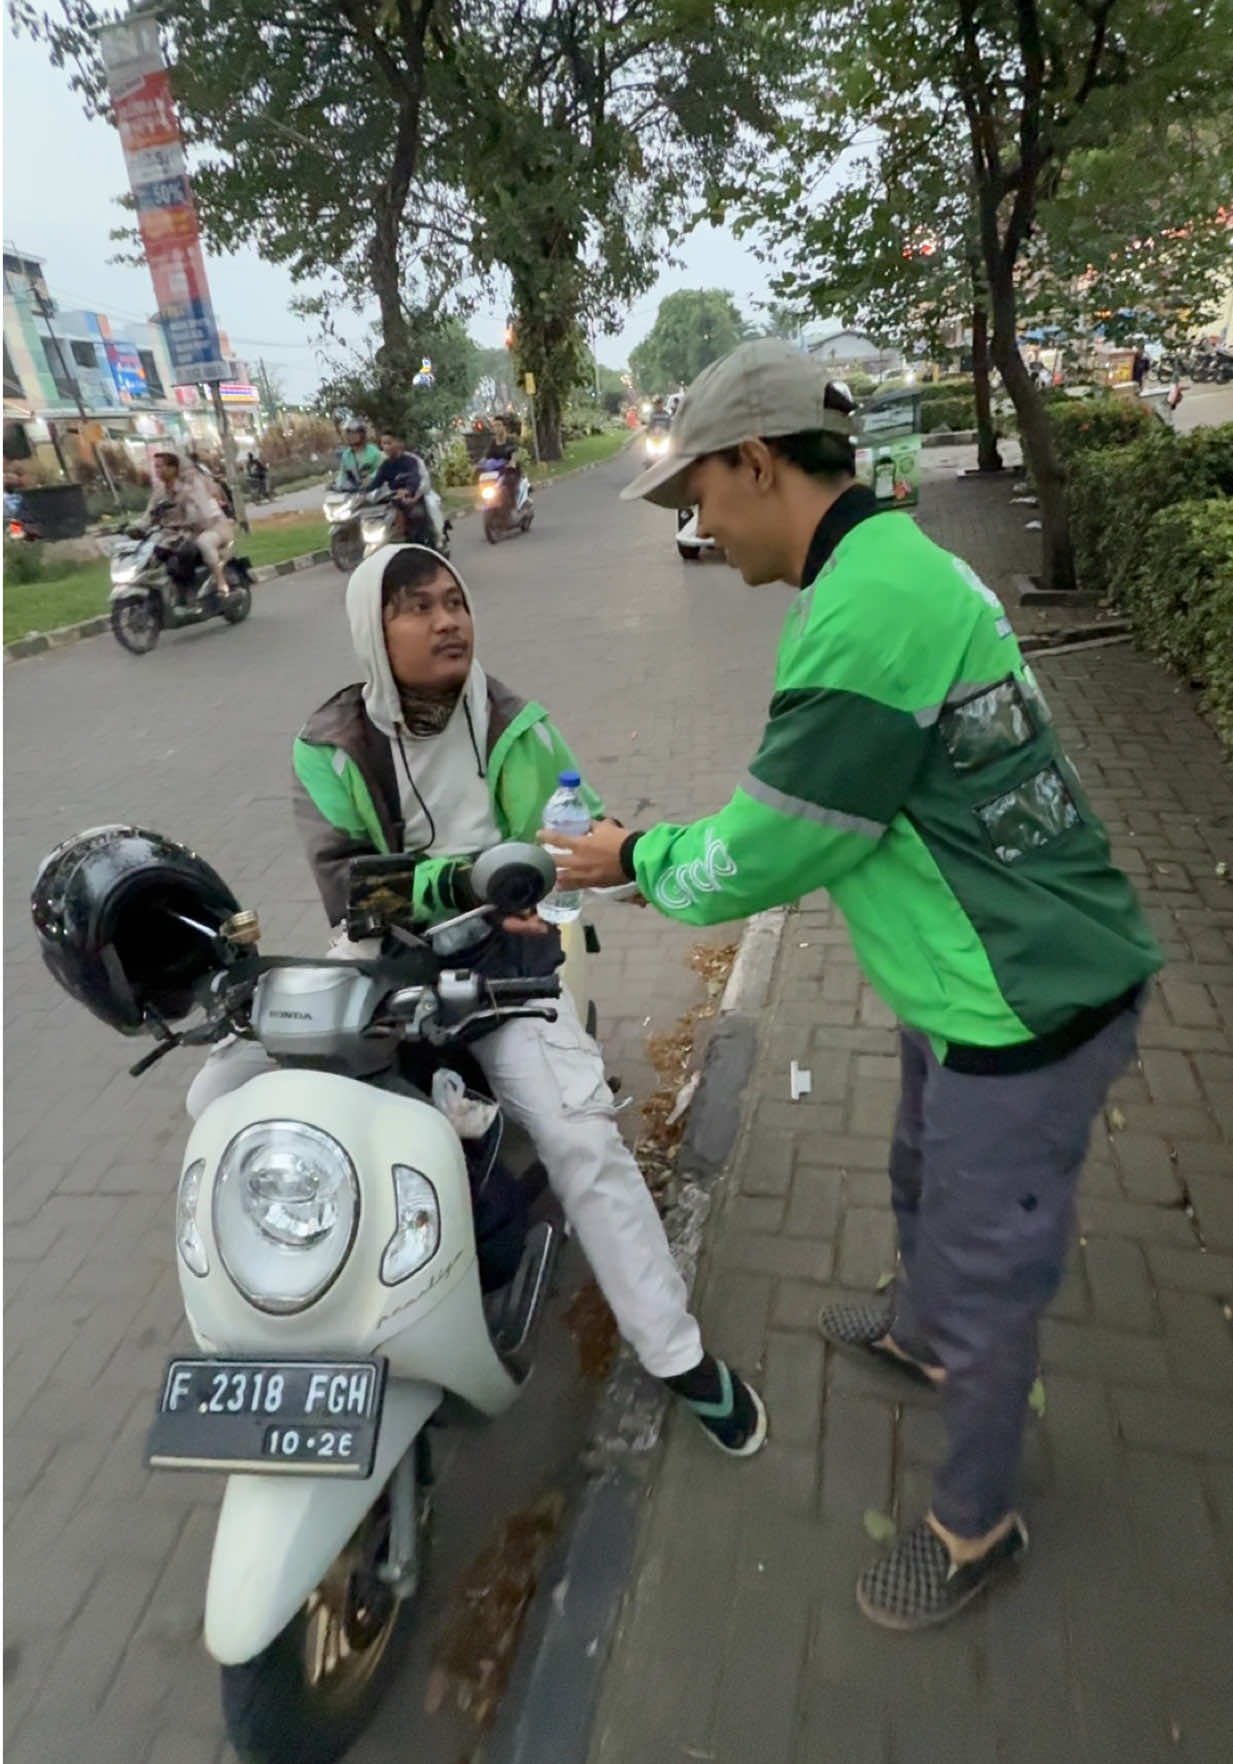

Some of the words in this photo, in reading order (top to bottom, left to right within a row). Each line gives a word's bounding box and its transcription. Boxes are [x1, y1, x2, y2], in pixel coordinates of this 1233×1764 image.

[169, 1372, 192, 1411] F
[209, 1373, 284, 1413] 2318
[305, 1374, 368, 1414] FGH
